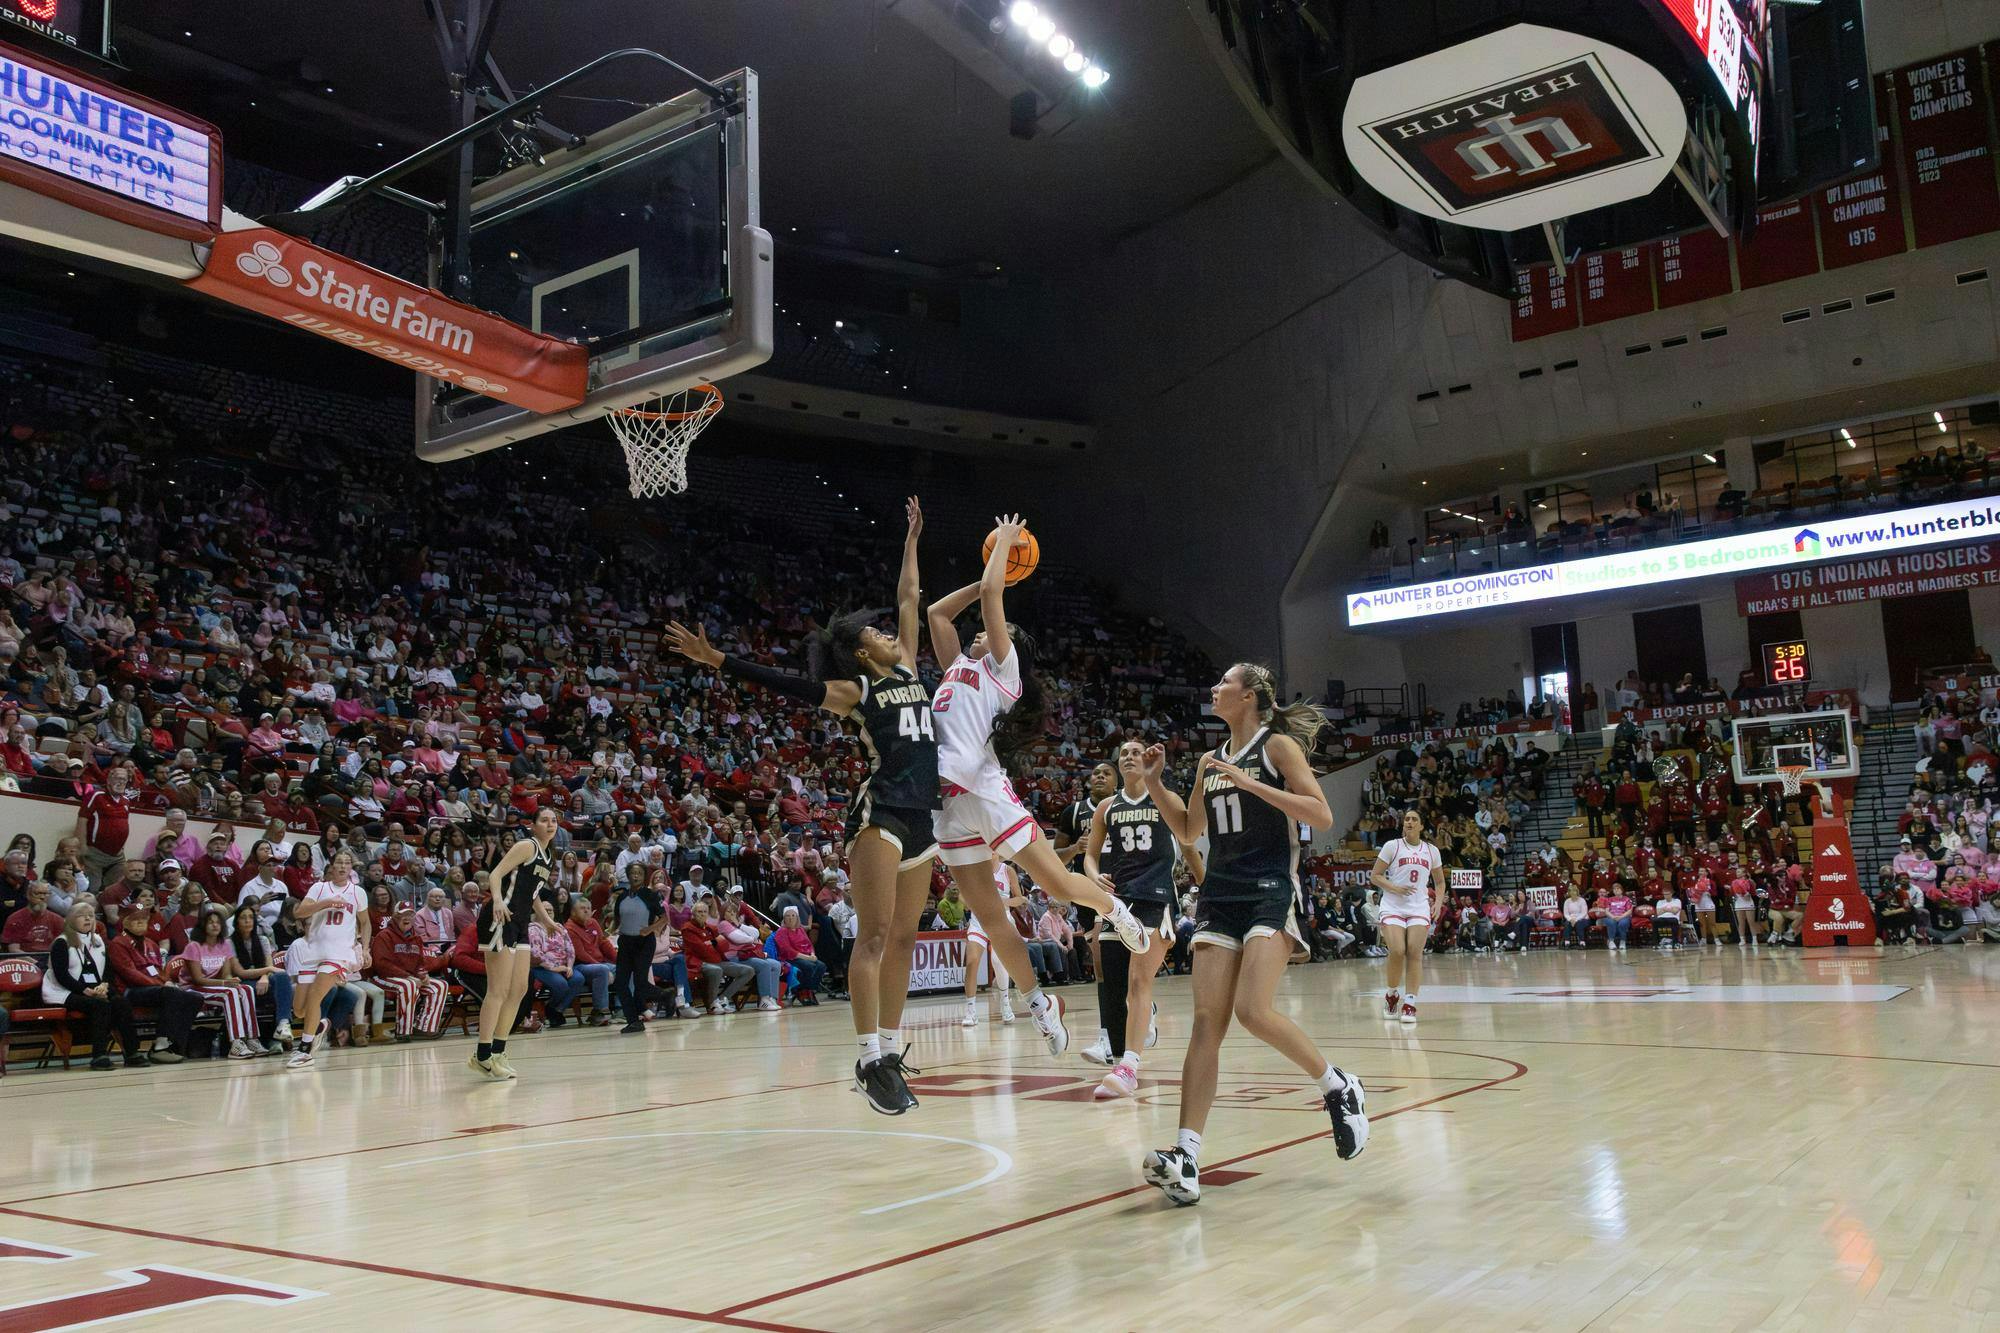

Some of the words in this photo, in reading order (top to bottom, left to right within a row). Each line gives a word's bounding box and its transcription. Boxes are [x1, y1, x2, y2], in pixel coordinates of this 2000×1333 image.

[1719, 5, 1736, 57] 5:30
[1719, 54, 1731, 87] 4TH
[1907, 57, 1966, 87] WOMEN'S
[1913, 83, 1933, 103] BIG
[1940, 74, 1966, 95] TEN
[0, 62, 175, 157] HUNTER
[1394, 72, 1581, 139] HEALTH
[1909, 90, 1973, 121] CHAMPIONS
[1844, 174, 1888, 200] NATIONAL
[1918, 170, 1940, 185] 2023
[1833, 196, 1886, 223] CHAMPIONS
[1848, 226, 1876, 247] 1975
[1565, 562, 1637, 587] Studios
[1641, 561, 1662, 575] to
[1667, 556, 1679, 571] 5
[1684, 540, 1790, 569] Bedrooms
[1770, 570, 1813, 592] 1976
[1818, 557, 1892, 585] INDIANA
[1896, 544, 1992, 575] HOOSIERS
[1373, 585, 1433, 607] HUNTER
[1435, 568, 1554, 598] BLOOMINGTON
[1747, 597, 1789, 615] NCAA'S
[1791, 595, 1806, 608] #1
[1810, 587, 1866, 607] ALL-TIME
[1868, 580, 1914, 600] MARCH
[1917, 571, 1979, 593] MADNESS
[1983, 569, 2000, 584] TE
[1416, 590, 1509, 613] PROPERTIES
[1775, 644, 1805, 659] 5:30
[1774, 657, 1805, 681] 26
[933, 688, 955, 713] 2
[1652, 701, 1727, 720] HOOSIER
[898, 705, 935, 742] 44
[1371, 729, 1433, 746] HOOSIR
[1111, 808, 1160, 826] PURDUE
[1211, 793, 1243, 834] 11
[1119, 824, 1153, 853] 33
[1409, 869, 1418, 884] 8
[1452, 873, 1482, 887] BASKET
[1820, 871, 1848, 883] meijer
[325, 911, 344, 926] 10
[1813, 920, 1866, 931] Smithville
